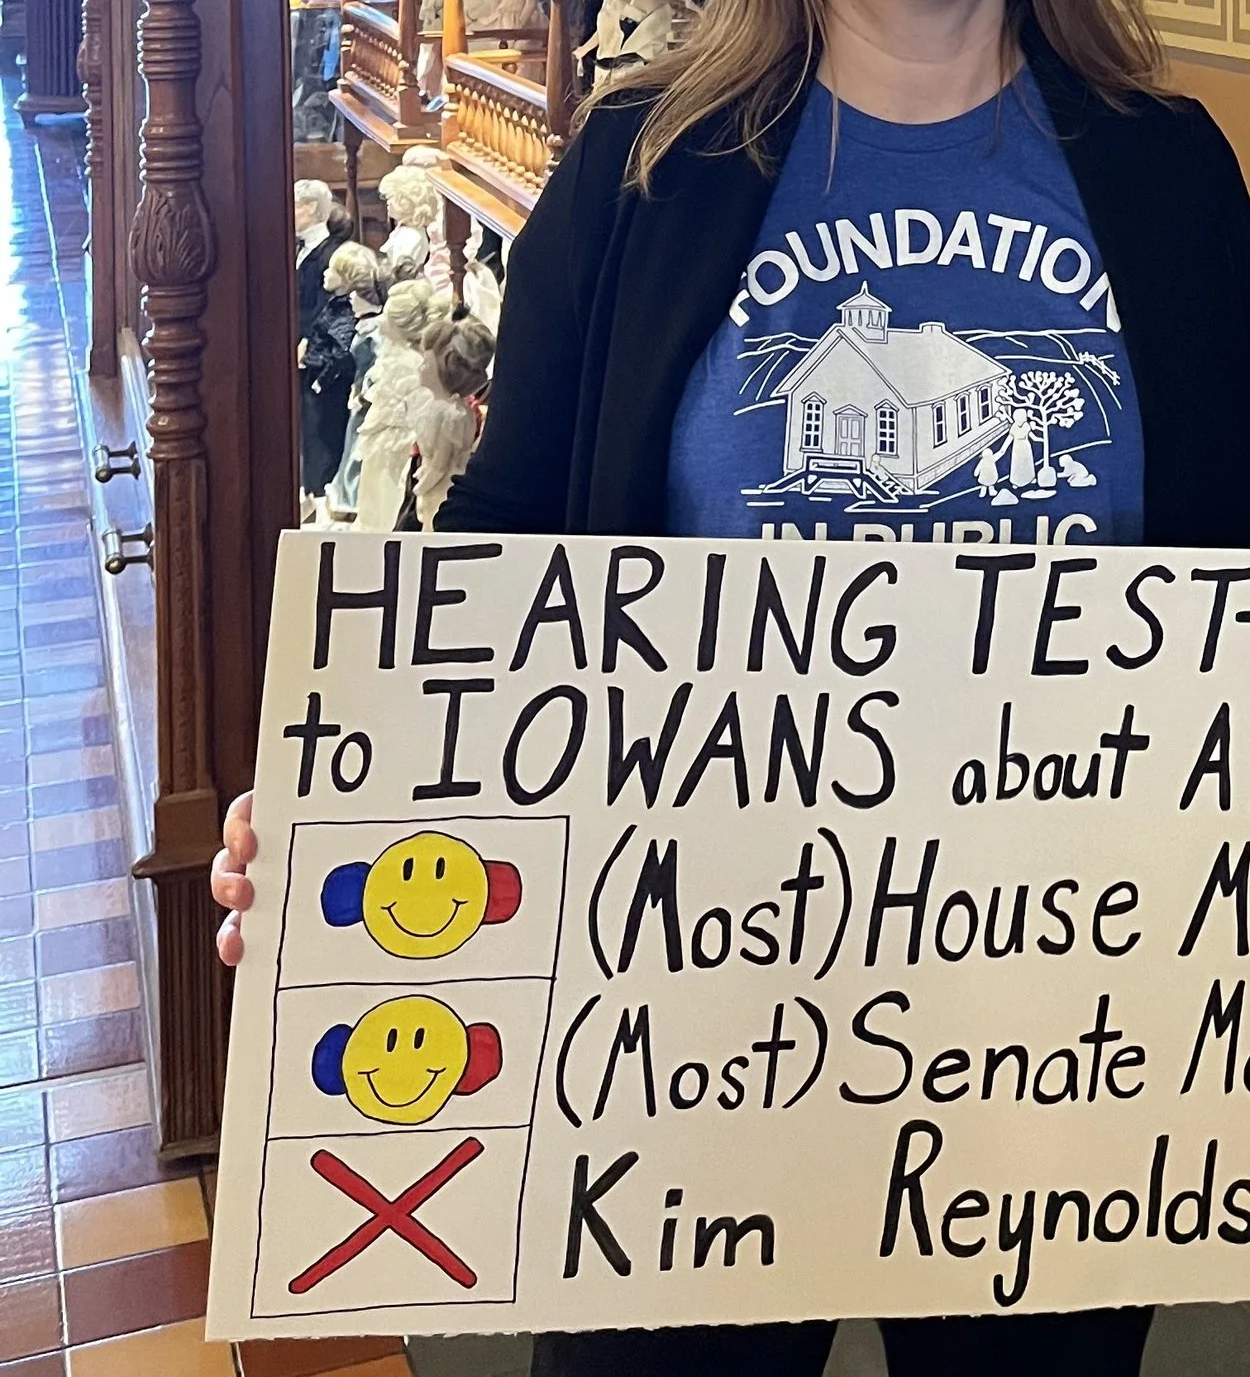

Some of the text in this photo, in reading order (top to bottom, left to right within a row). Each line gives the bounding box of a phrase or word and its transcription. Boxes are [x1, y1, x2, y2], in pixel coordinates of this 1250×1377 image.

[313, 540, 898, 677] HEARING
[283, 691, 373, 798] to
[411, 678, 900, 810] IOWANS
[952, 701, 1150, 806] about
[562, 1151, 775, 1279] Kim
